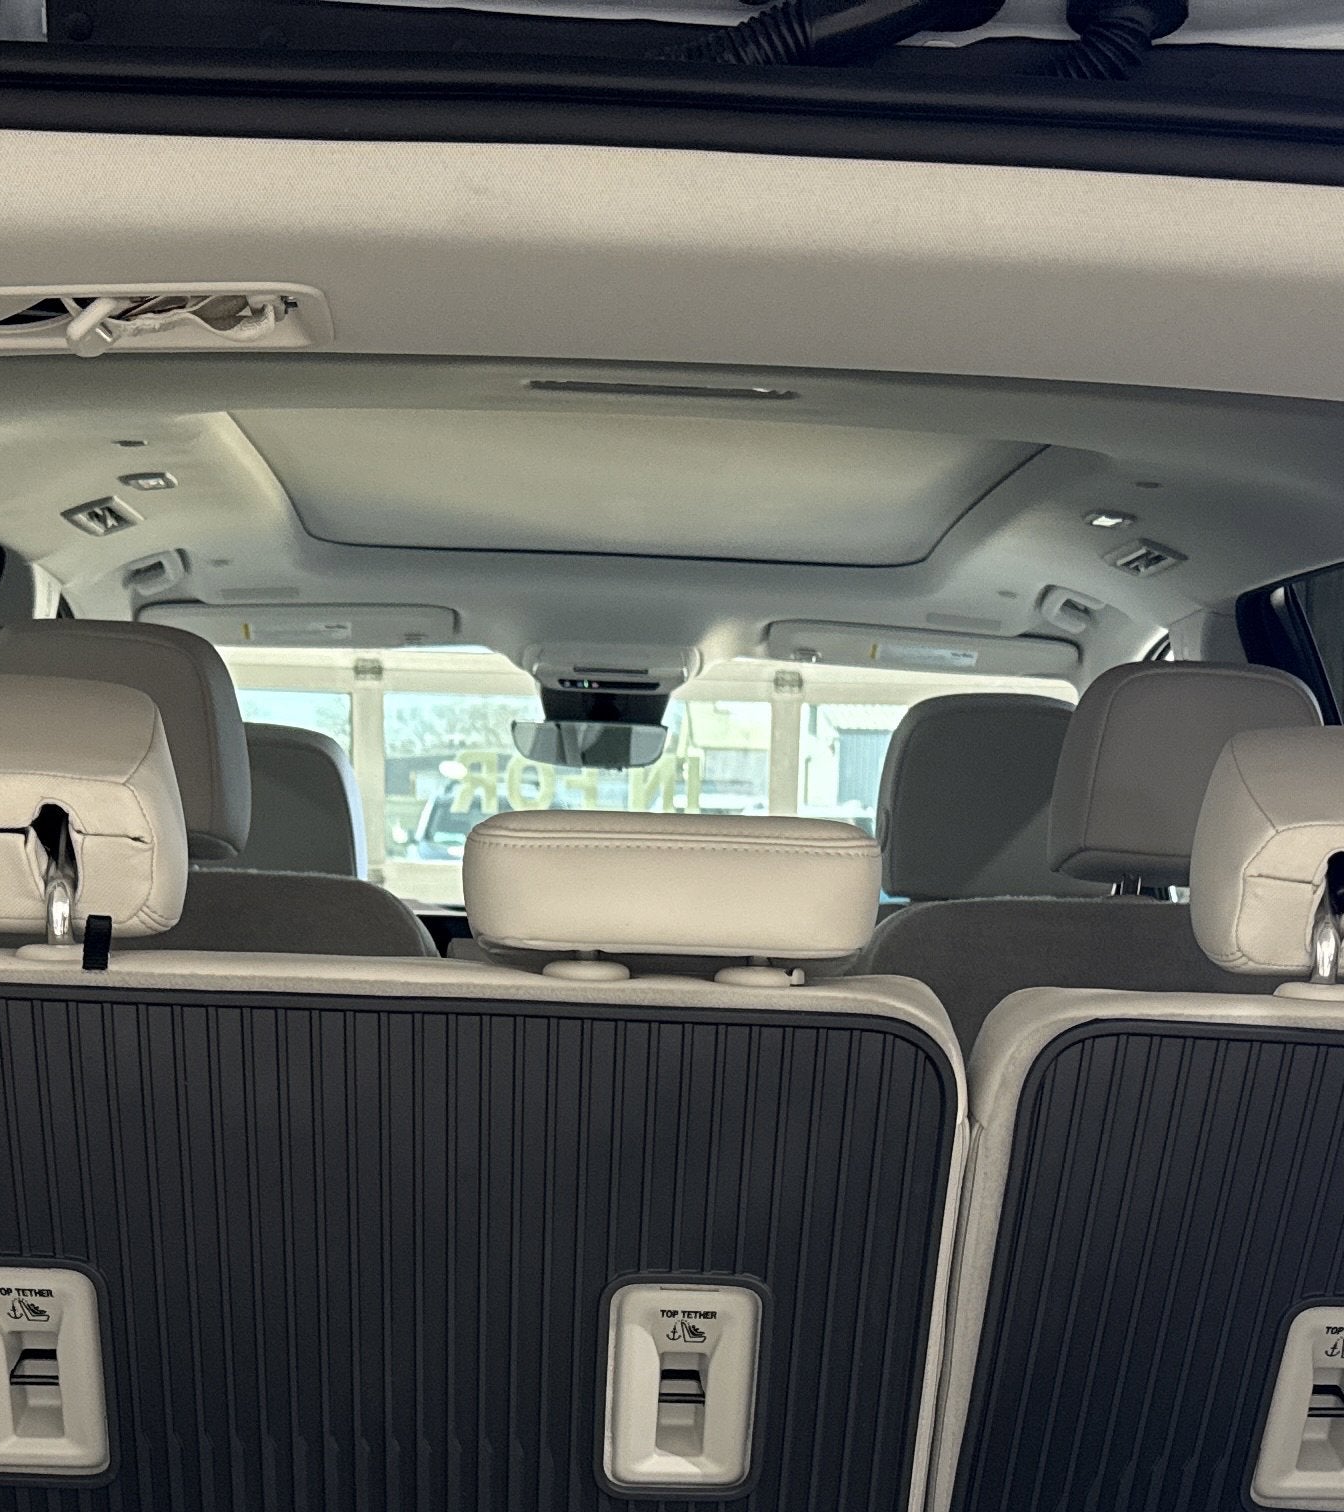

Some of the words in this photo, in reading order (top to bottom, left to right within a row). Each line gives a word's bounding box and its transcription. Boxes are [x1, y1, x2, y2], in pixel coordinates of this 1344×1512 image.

[14, 1287, 54, 1298] TETHER
[659, 1309, 678, 1319] TOP
[681, 1310, 717, 1320] TETHER
[1325, 1326, 1344, 1335] TOP
